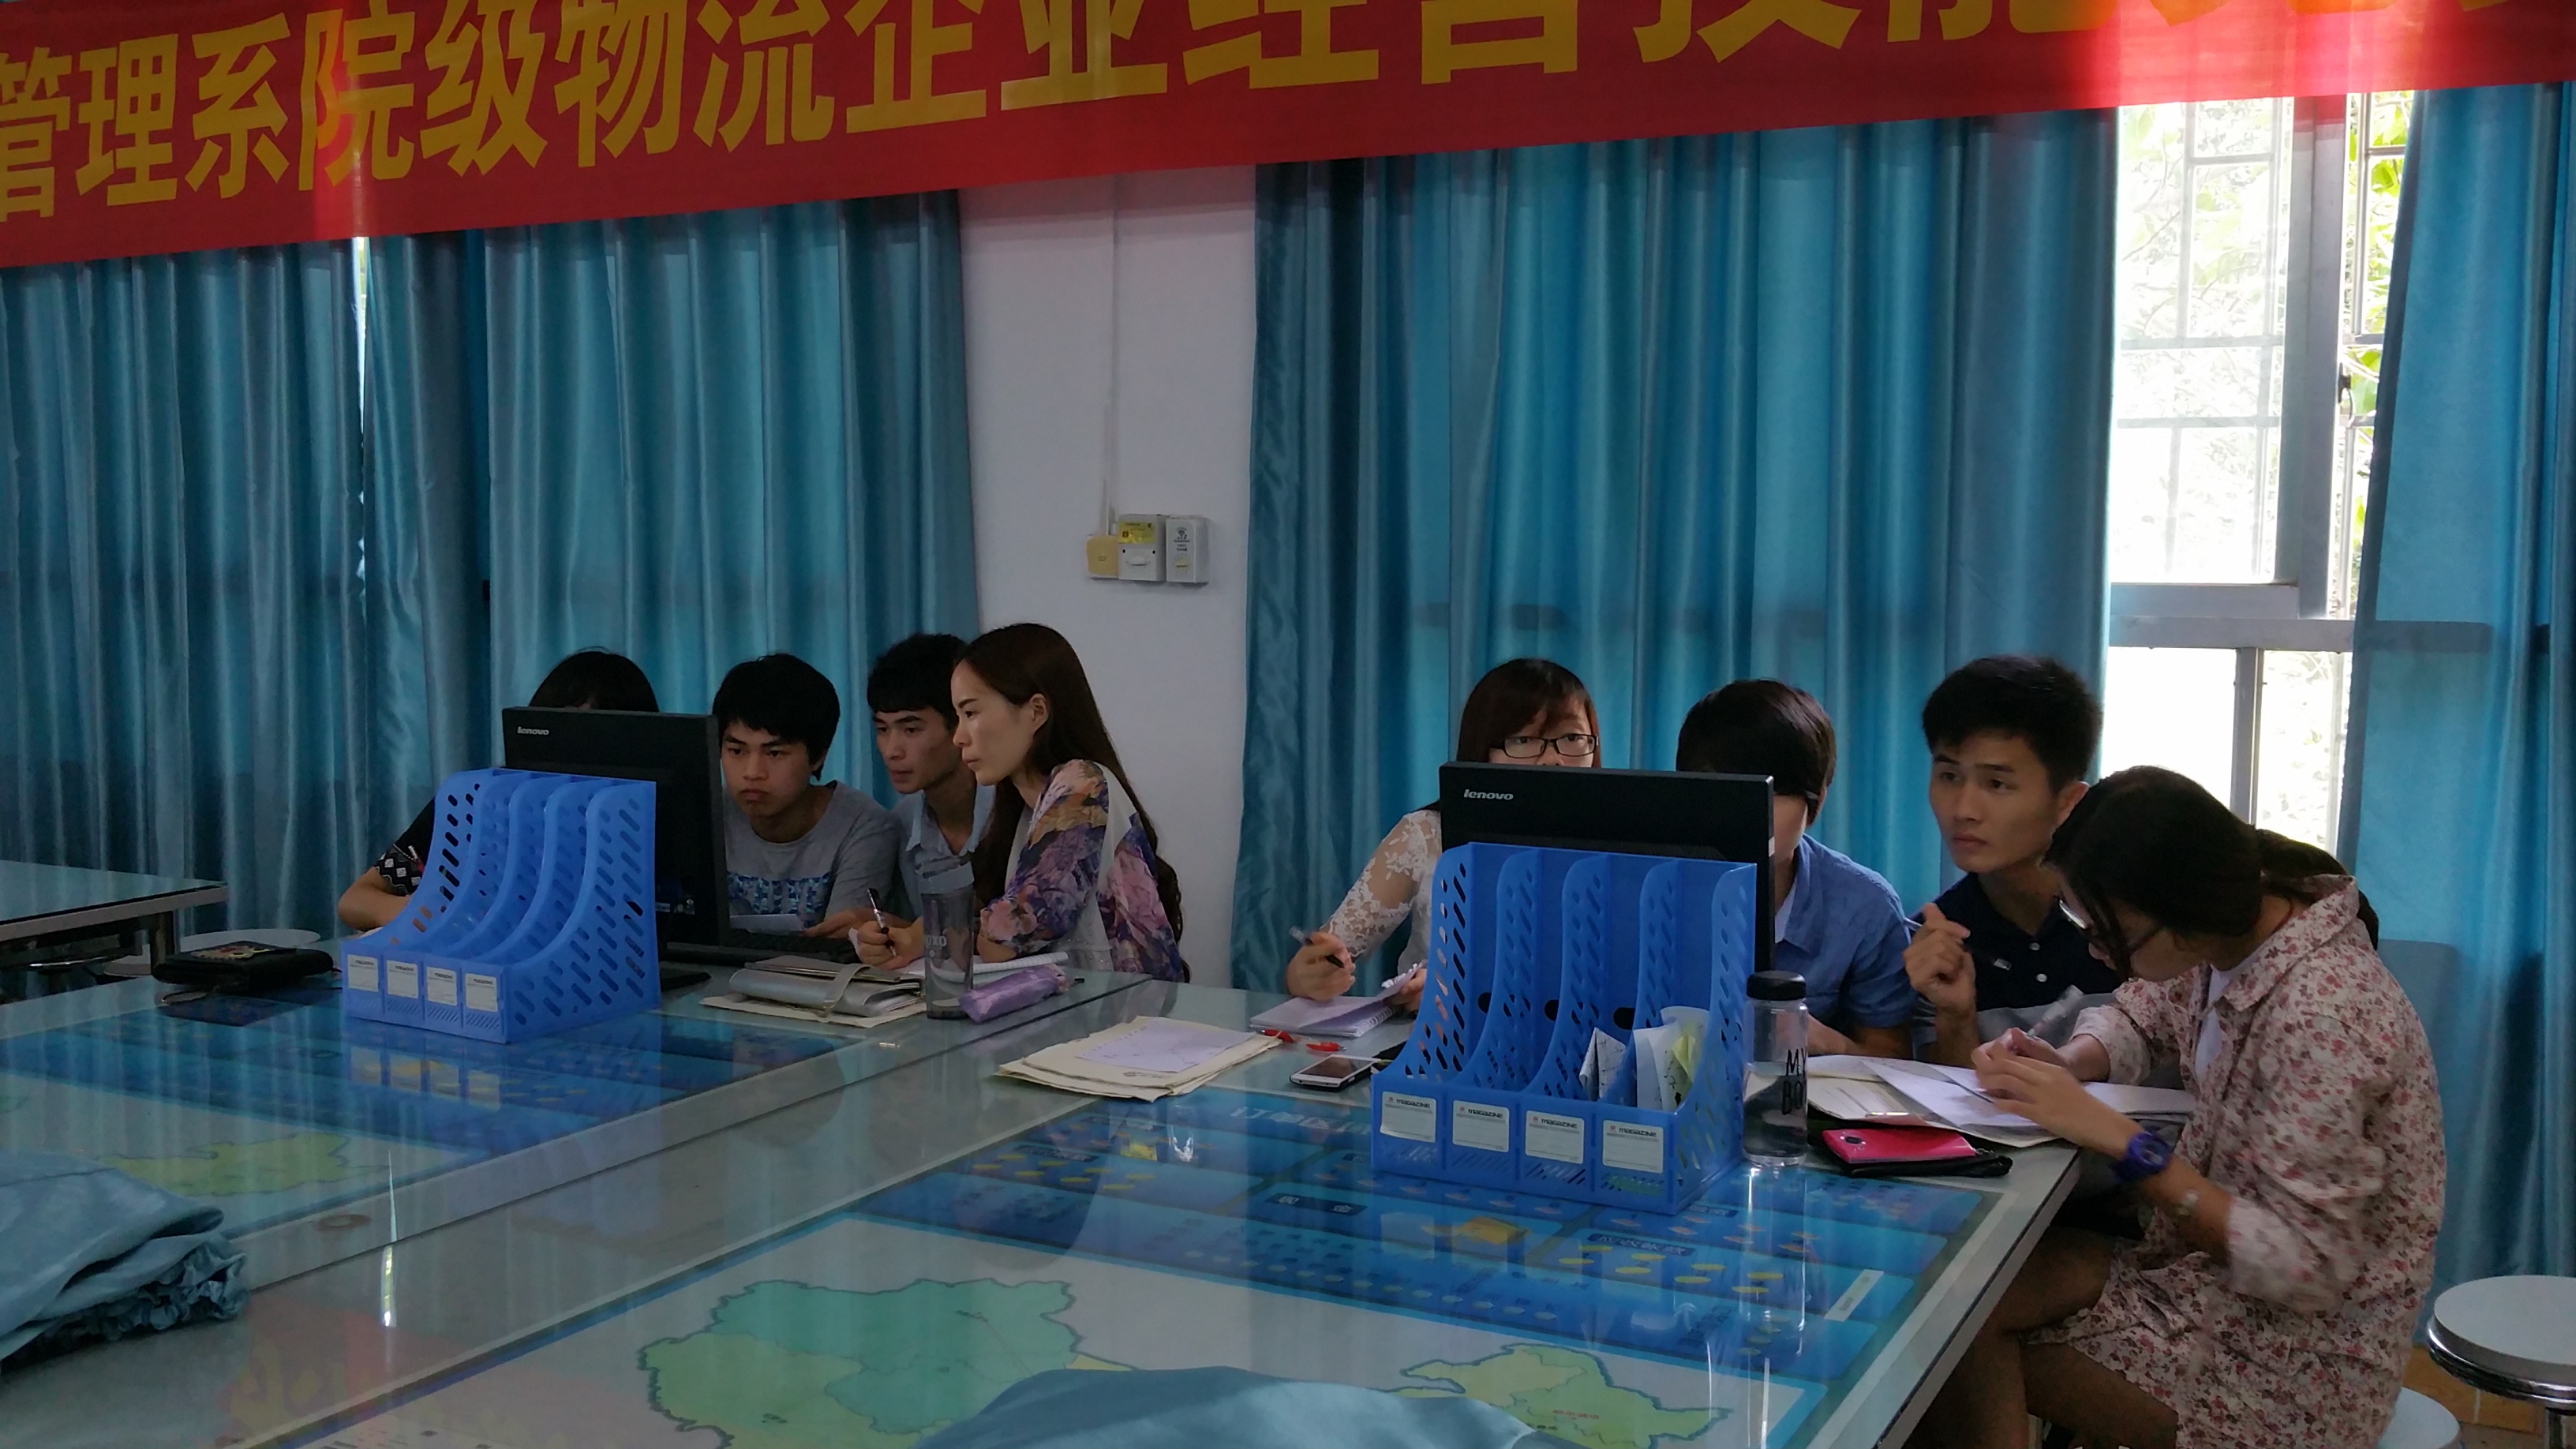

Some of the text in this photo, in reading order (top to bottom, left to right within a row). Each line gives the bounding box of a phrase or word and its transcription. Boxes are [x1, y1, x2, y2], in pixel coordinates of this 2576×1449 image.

[517, 726, 549, 736] lenovo
[1463, 789, 1514, 800] lenovo
[1786, 1047, 1807, 1076] MY
